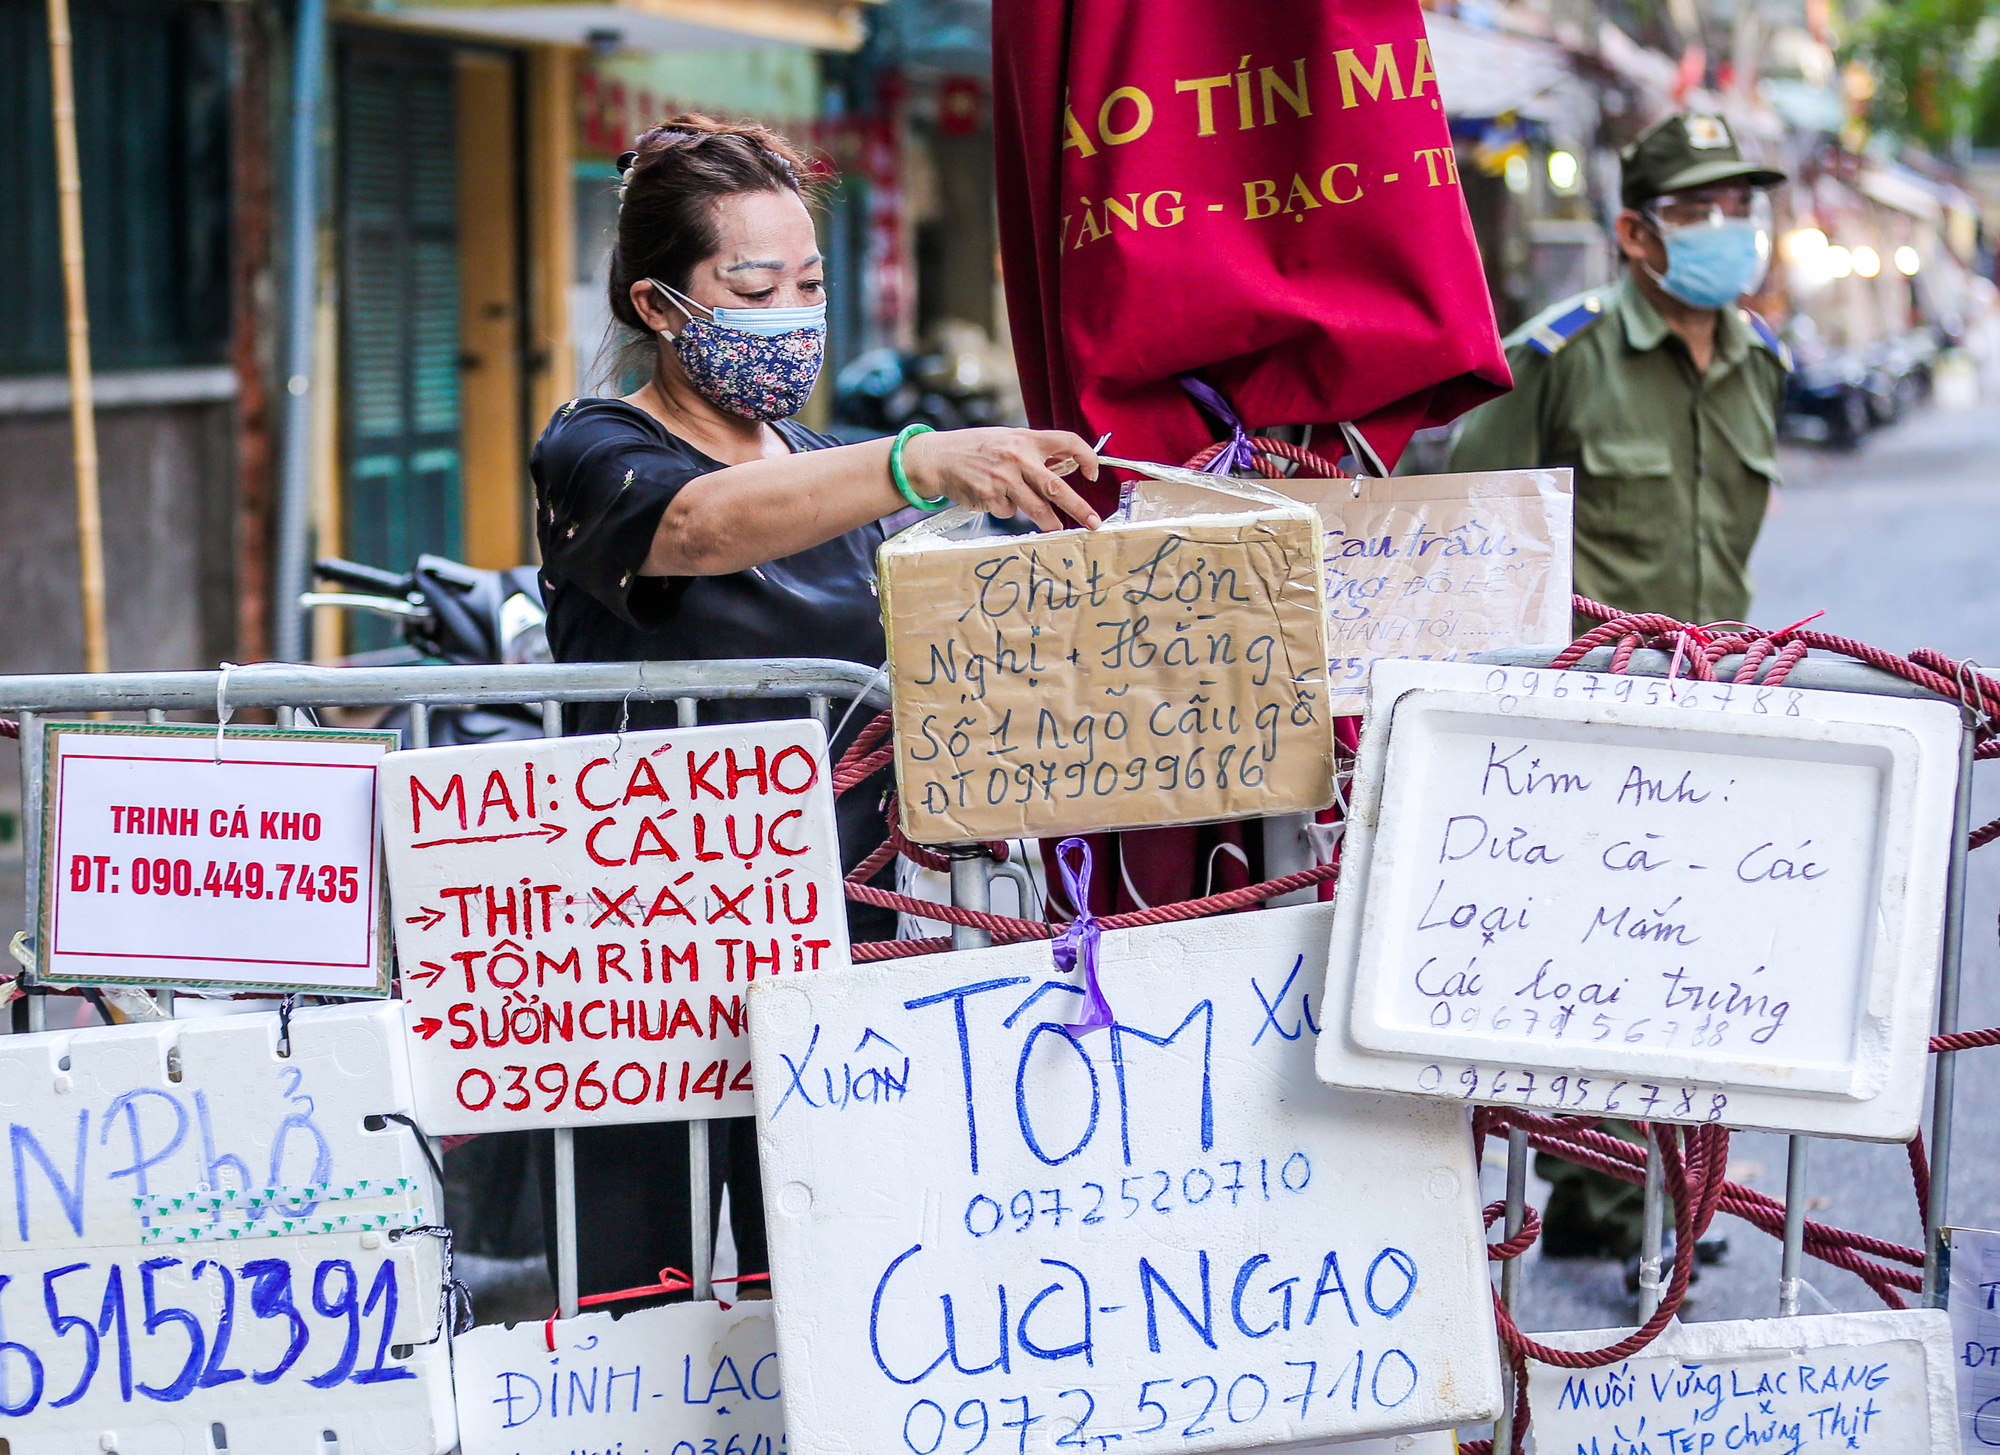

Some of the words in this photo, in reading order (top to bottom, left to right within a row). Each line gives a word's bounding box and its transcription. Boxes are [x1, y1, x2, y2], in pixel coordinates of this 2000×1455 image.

[1175, 55, 1313, 138] TÍN
[1332, 38, 1442, 111] MẠ
[1242, 162, 1364, 224] BẠC
[576, 743, 671, 811] CÁ
[687, 745, 819, 801] KHO
[986, 744, 1265, 807] 0979099686
[1481, 742, 1592, 797] Kim
[110, 805, 199, 837] TRINH
[209, 803, 249, 839] CÁ
[259, 811, 323, 842] KHO
[586, 808, 681, 867] CÁ
[695, 809, 812, 870] LỤC
[70, 854, 120, 895] ĐT:
[131, 856, 359, 904] 090.449.7435
[1736, 838, 1831, 885] Các
[451, 939, 582, 993] TÔM
[904, 976, 1215, 1176] TÔM
[963, 1152, 1312, 1238] 0972520710
